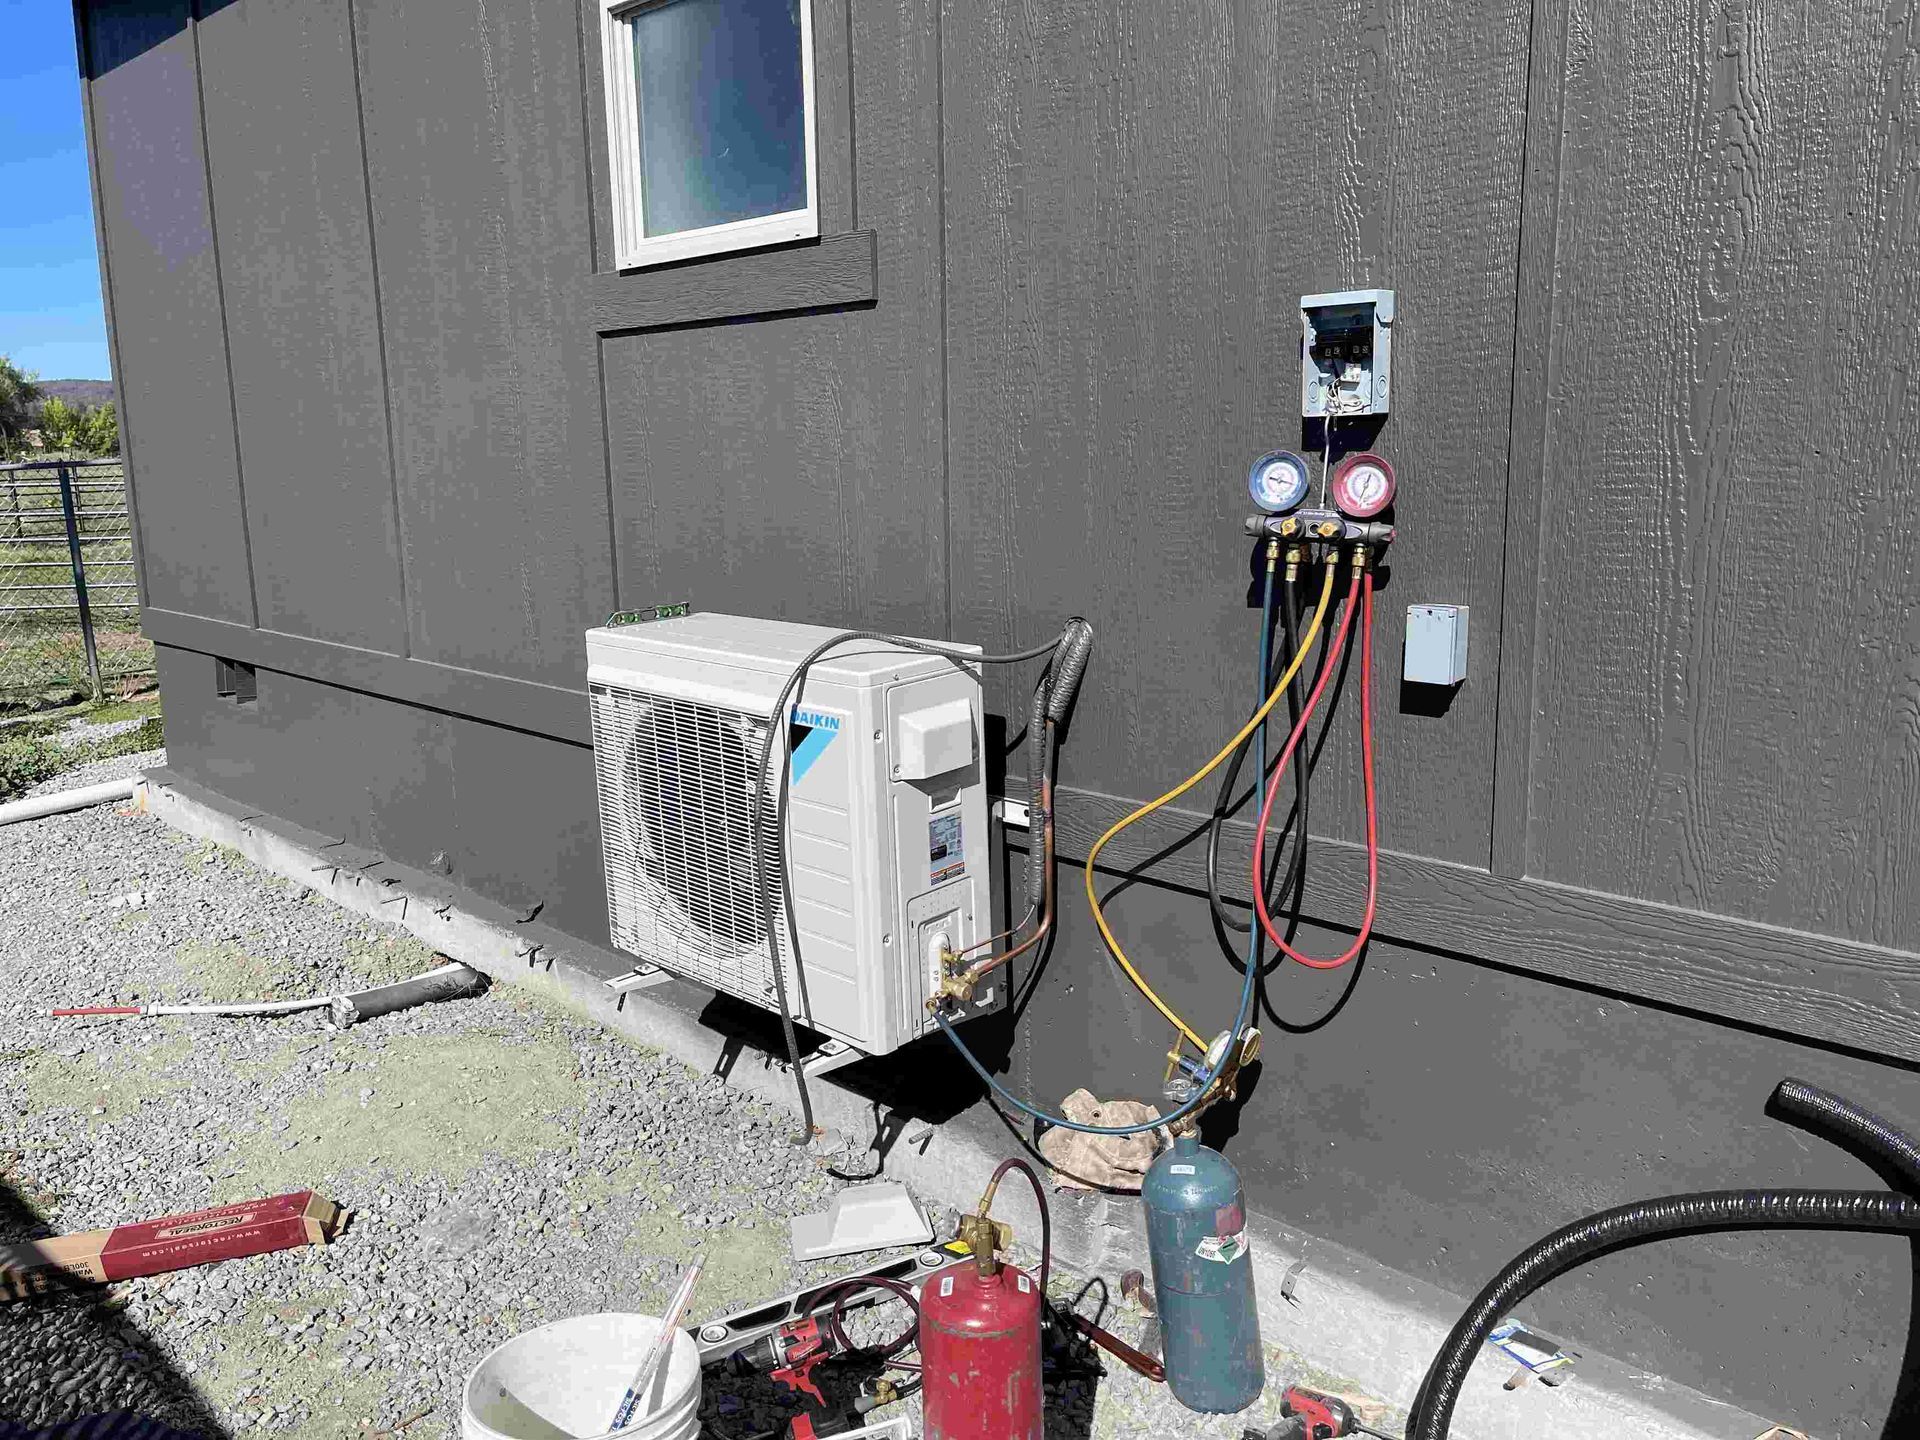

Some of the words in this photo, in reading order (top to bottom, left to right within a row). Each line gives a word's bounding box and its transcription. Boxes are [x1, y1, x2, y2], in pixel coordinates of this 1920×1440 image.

[792, 711, 840, 729] DAIKIN
[168, 1215, 244, 1236] RECTORSEAL
[143, 1230, 260, 1257] www.rectorseal.com
